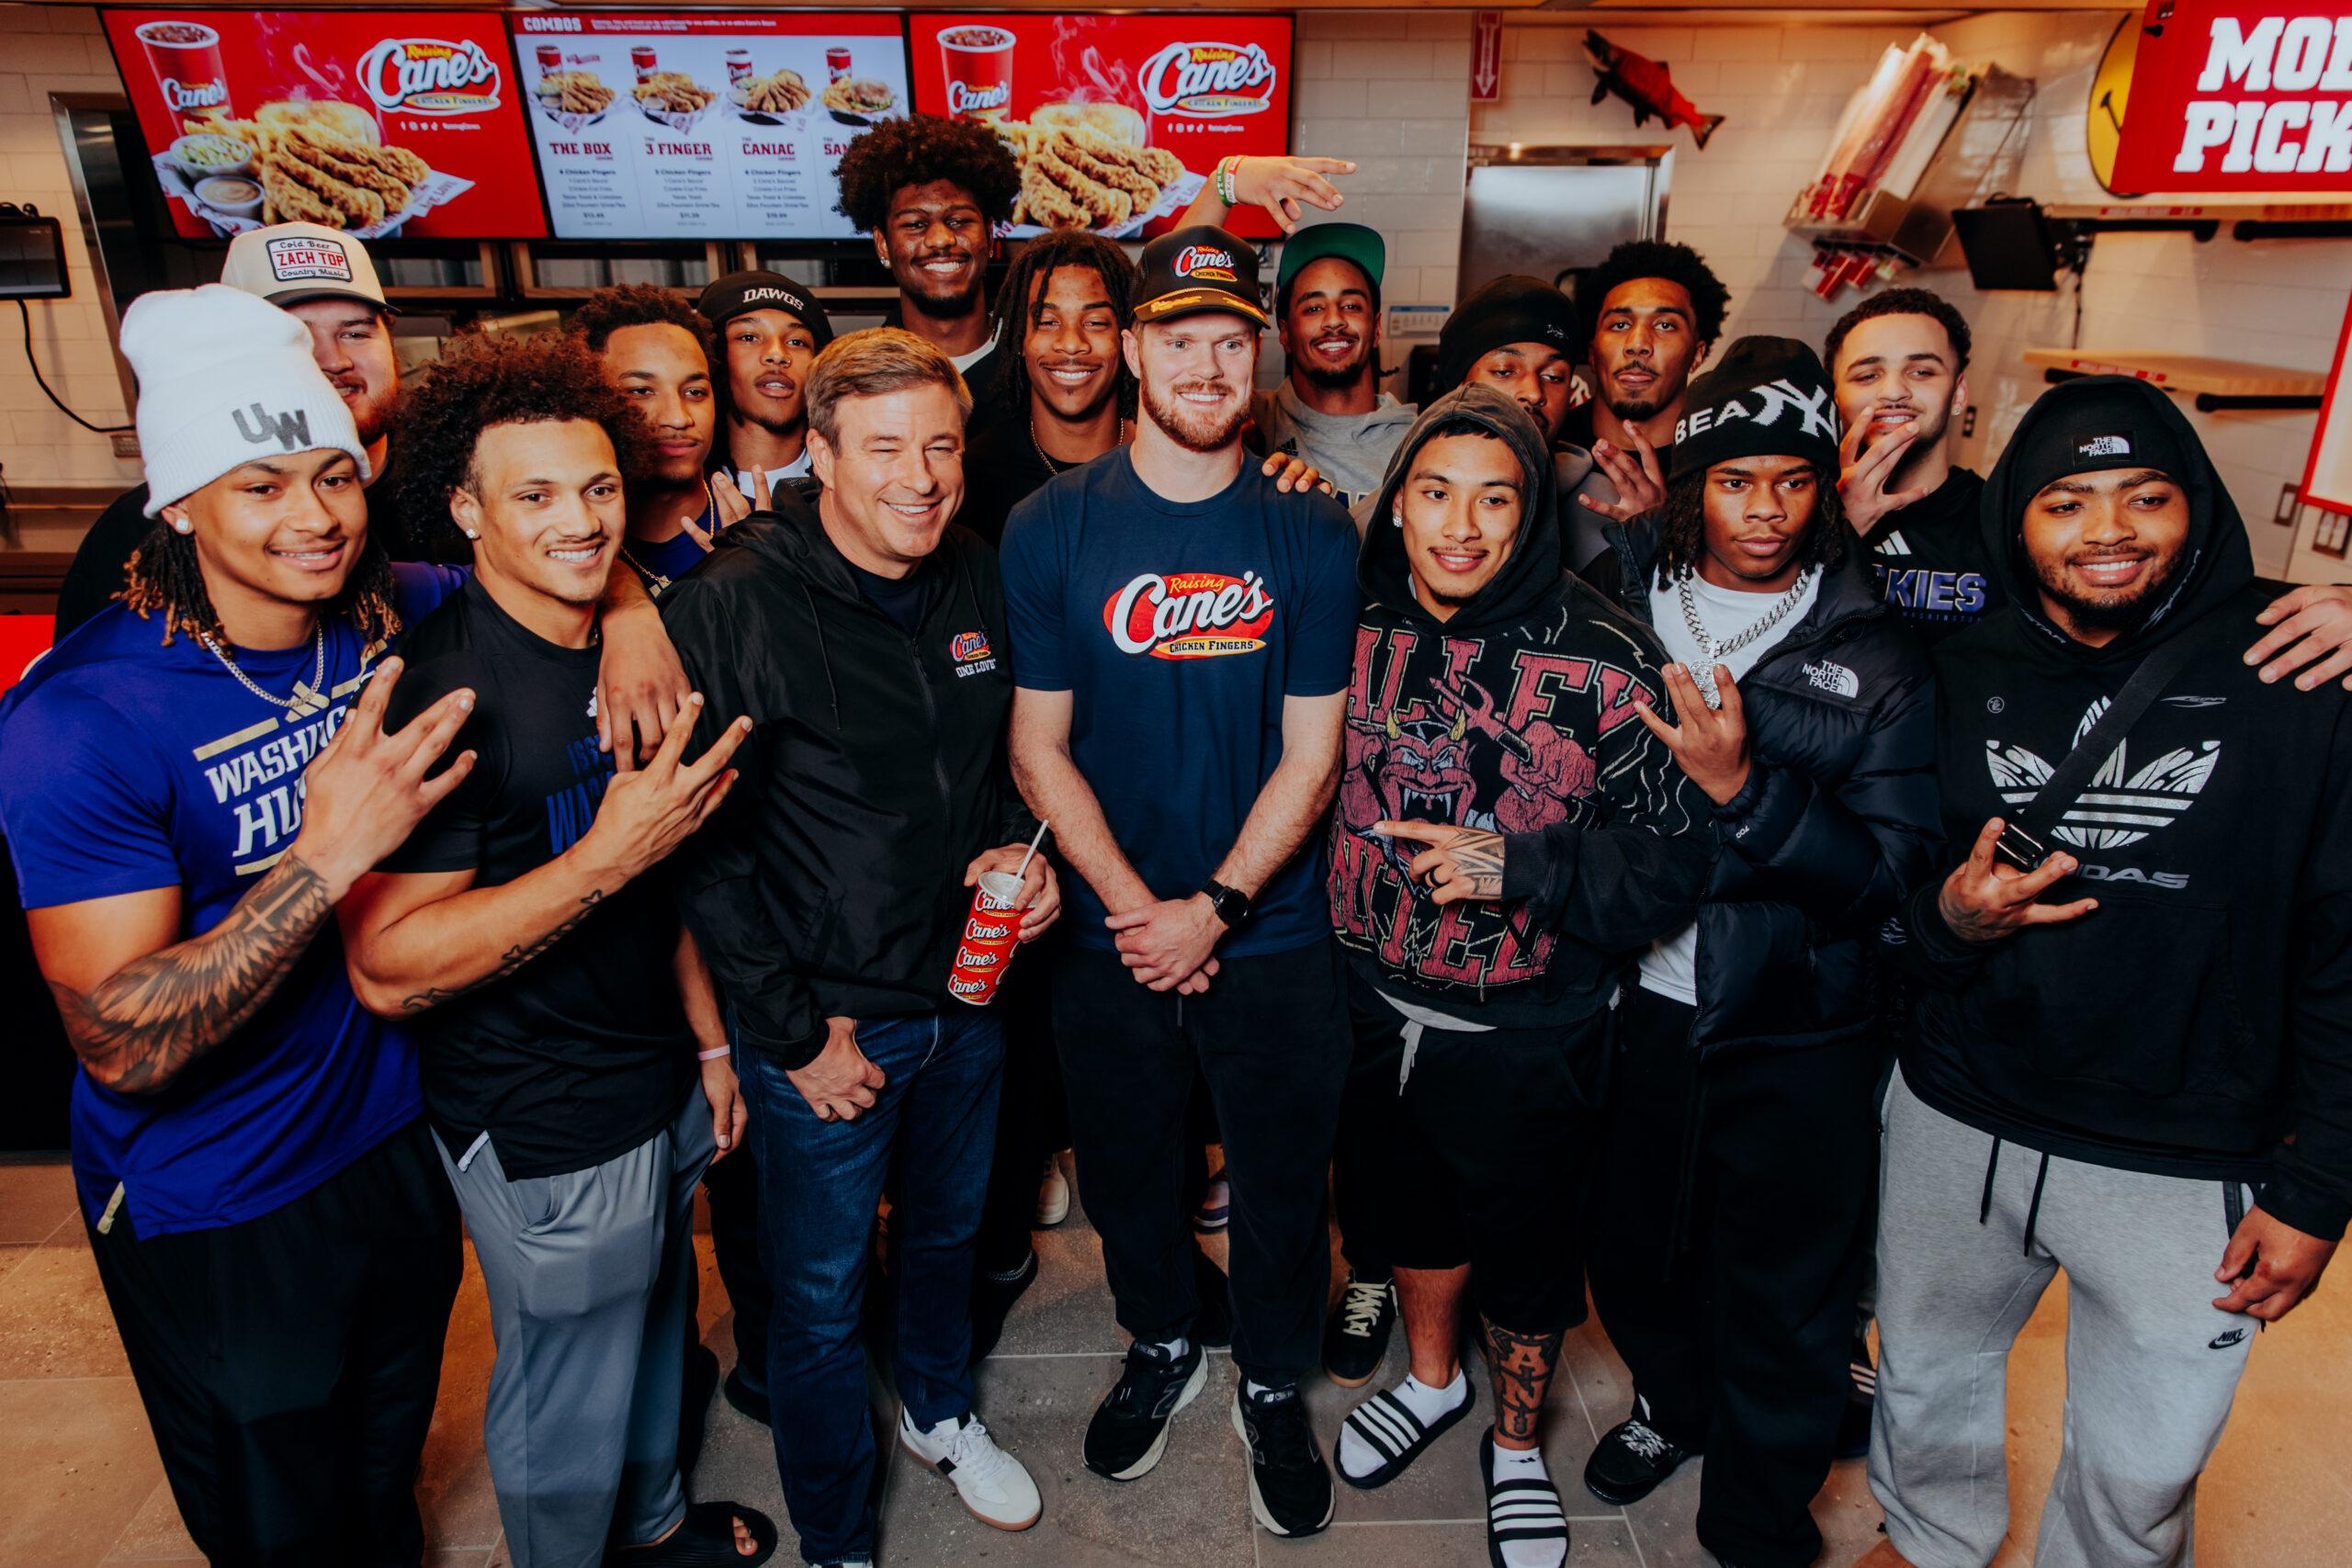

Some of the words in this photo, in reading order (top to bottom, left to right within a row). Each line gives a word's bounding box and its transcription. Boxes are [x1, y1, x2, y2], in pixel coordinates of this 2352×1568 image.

[523, 17, 582, 32] COMBOS
[367, 39, 493, 108] Cane's
[1148, 42, 1272, 109] Cane's
[549, 142, 579, 155] THE
[583, 142, 612, 155] BOX
[645, 143, 654, 155] 3
[658, 143, 712, 155] FINGER
[742, 143, 795, 155] CANIAC
[277, 252, 316, 266] ZACH
[319, 252, 345, 266] TOP
[1175, 246, 1235, 277] Cane's
[319, 269, 345, 277] Music
[742, 288, 804, 310] DAWGS
[232, 402, 312, 451] UW
[2079, 443, 2114, 454] NORTH
[2093, 436, 2114, 445] THE
[2088, 448, 2114, 457] FACE
[1170, 576, 1226, 593] Raising
[1872, 564, 1986, 613] KIES
[1112, 570, 1274, 654] Cane's
[952, 630, 988, 661] Cane's
[1170, 642, 1205, 653] CHICKEN
[1208, 640, 1254, 651] FINGERS
[956, 664, 975, 678] ONE
[974, 660, 995, 673] LOVE
[1802, 662, 1841, 684] NORTH
[1822, 660, 1843, 674] THE
[1809, 676, 1838, 694] FACE
[975, 890, 1014, 912] Cane
[966, 918, 1011, 940] Cane's
[956, 946, 1000, 968] Cane's
[947, 974, 989, 993] Cane's
[2217, 1327, 2244, 1341] NIKE
